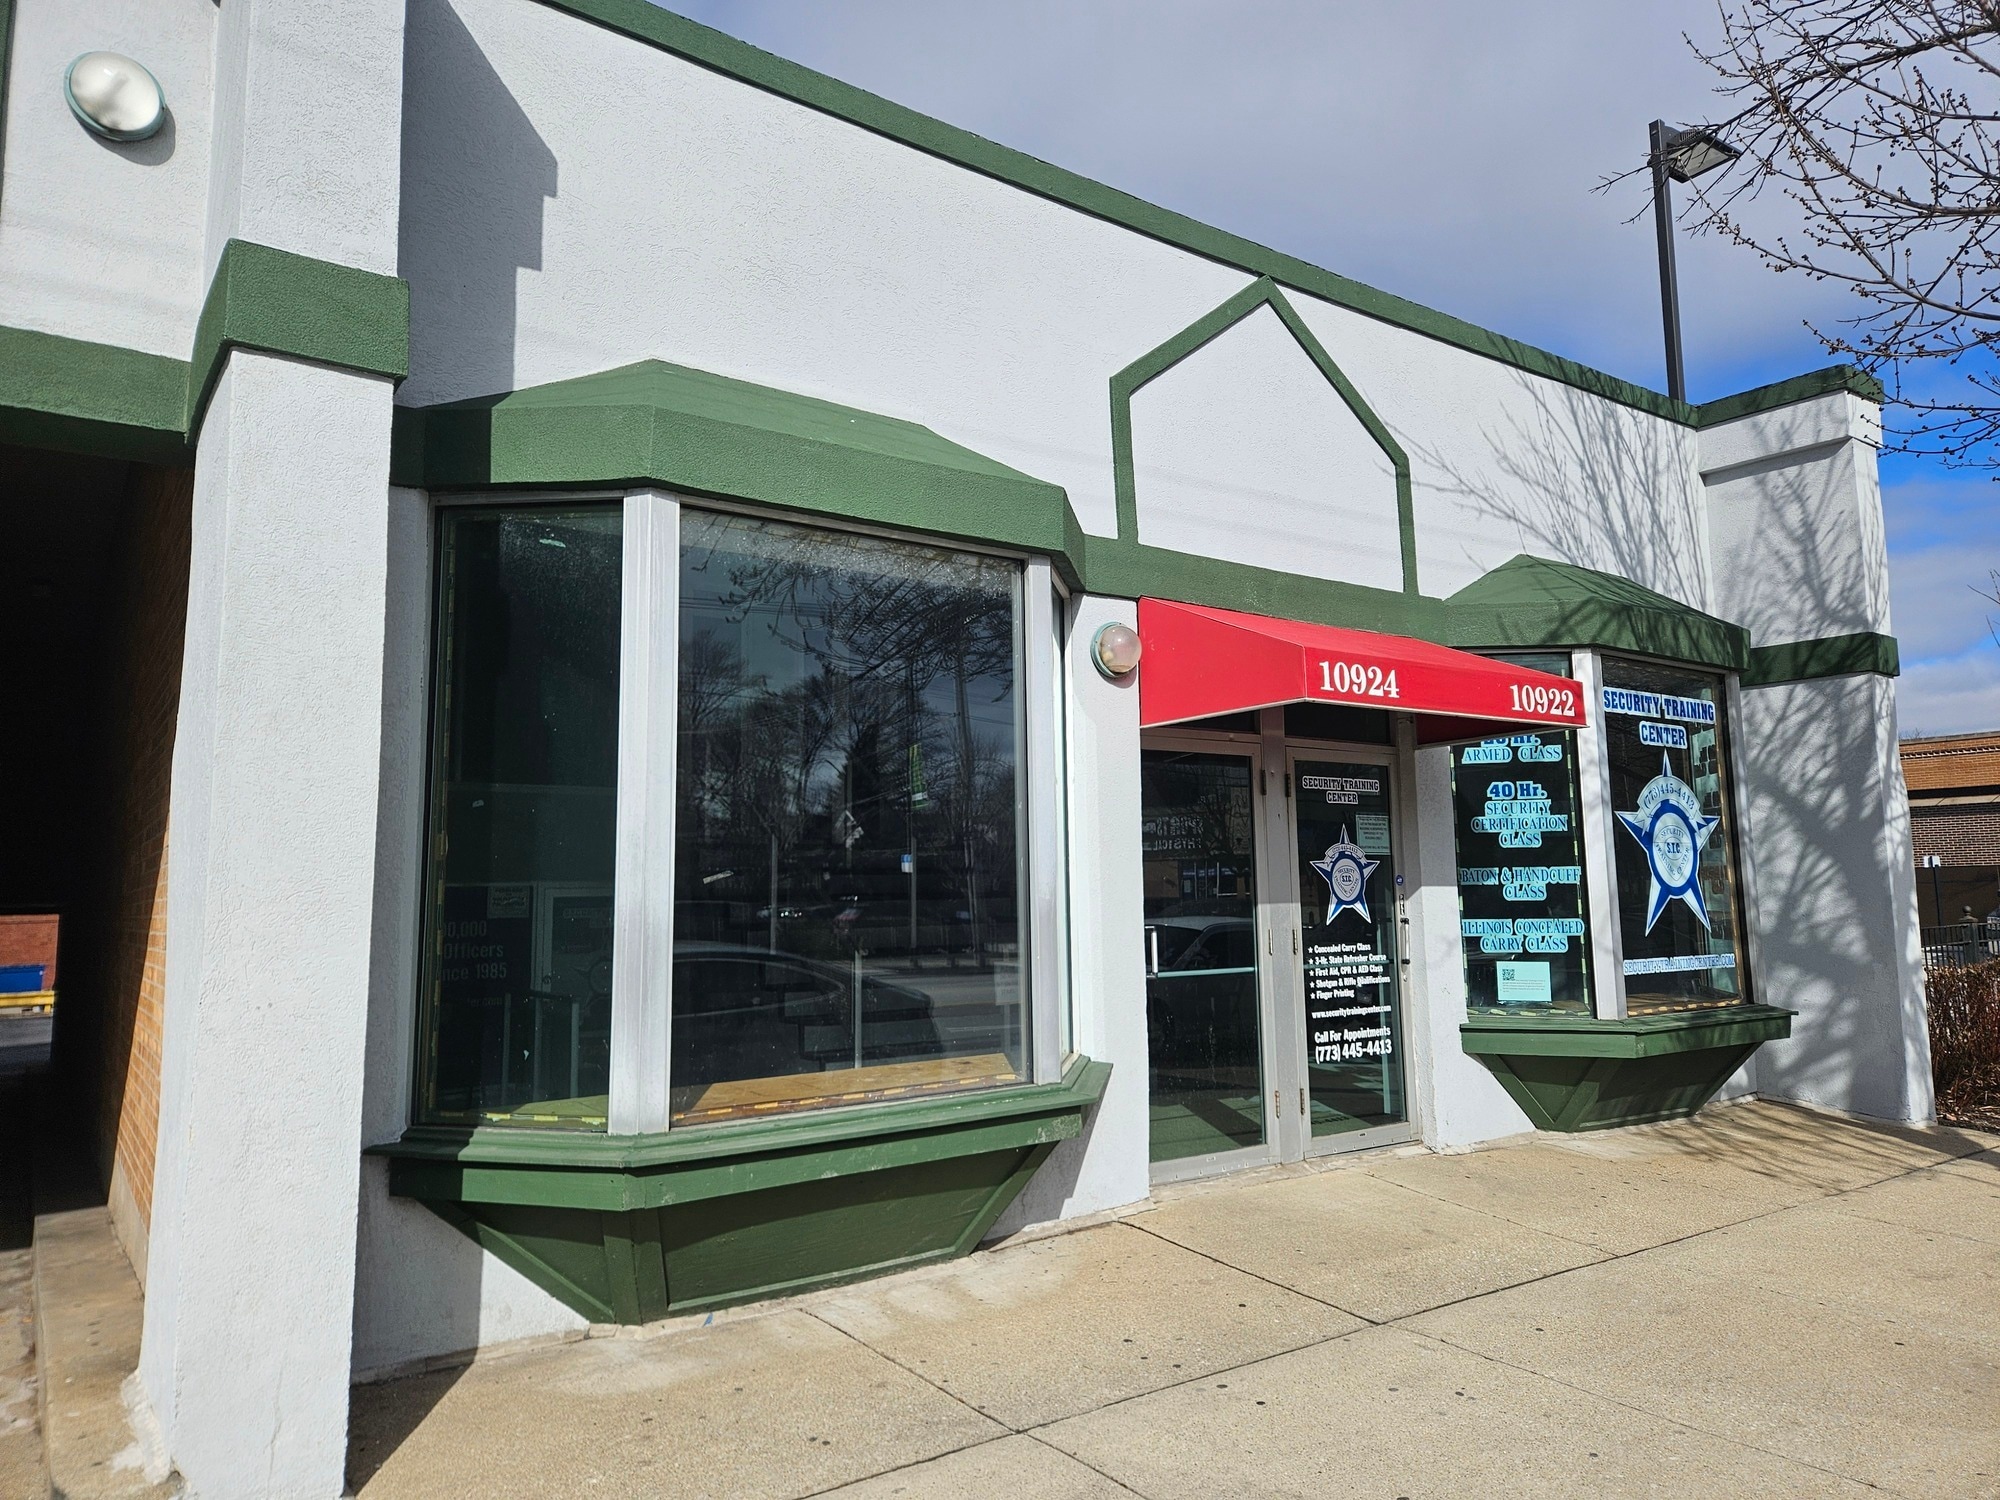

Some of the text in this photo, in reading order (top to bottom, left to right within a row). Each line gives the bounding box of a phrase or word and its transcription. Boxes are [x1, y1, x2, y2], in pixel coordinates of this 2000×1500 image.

[1319, 661, 1400, 698] 10924
[1510, 684, 1576, 716] 10922
[1603, 690, 1714, 721] SECURITY TRAINING
[1641, 725, 1685, 746] CENTER
[1464, 747, 1561, 762] ARMED CLASS
[1302, 778, 1379, 791] SECURITY TRAINING
[1490, 784, 1546, 797] 40 Hr.
[1327, 793, 1358, 803] CENTER
[1486, 802, 1550, 815] SECURITY
[1472, 817, 1568, 830] CERTIFICATION
[1501, 833, 1541, 846] CLASS
[1462, 868, 1580, 882] BATON & HANDCUFF
[1505, 886, 1545, 899] CLASS
[1463, 921, 1583, 934] ILLINOIS CONCEALED
[1314, 943, 1371, 953] Concealed Carry Class
[1481, 937, 1567, 950] CARRY CLASS
[443, 942, 504, 960] Officers
[1329, 956, 1342, 964] State
[1343, 954, 1368, 963] Refresher
[1369, 953, 1386, 961] Course
[475, 961, 507, 980] 1985
[1315, 964, 1383, 976] First Aid, CPR & AED Class
[1316, 975, 1391, 988] Shotgun & Rifle Qualifications
[1316, 989, 1355, 1000] Finger Printing
[1314, 1025, 1391, 1044] Call For Appointments
[1315, 1039, 1392, 1064] (773) 445-4413
